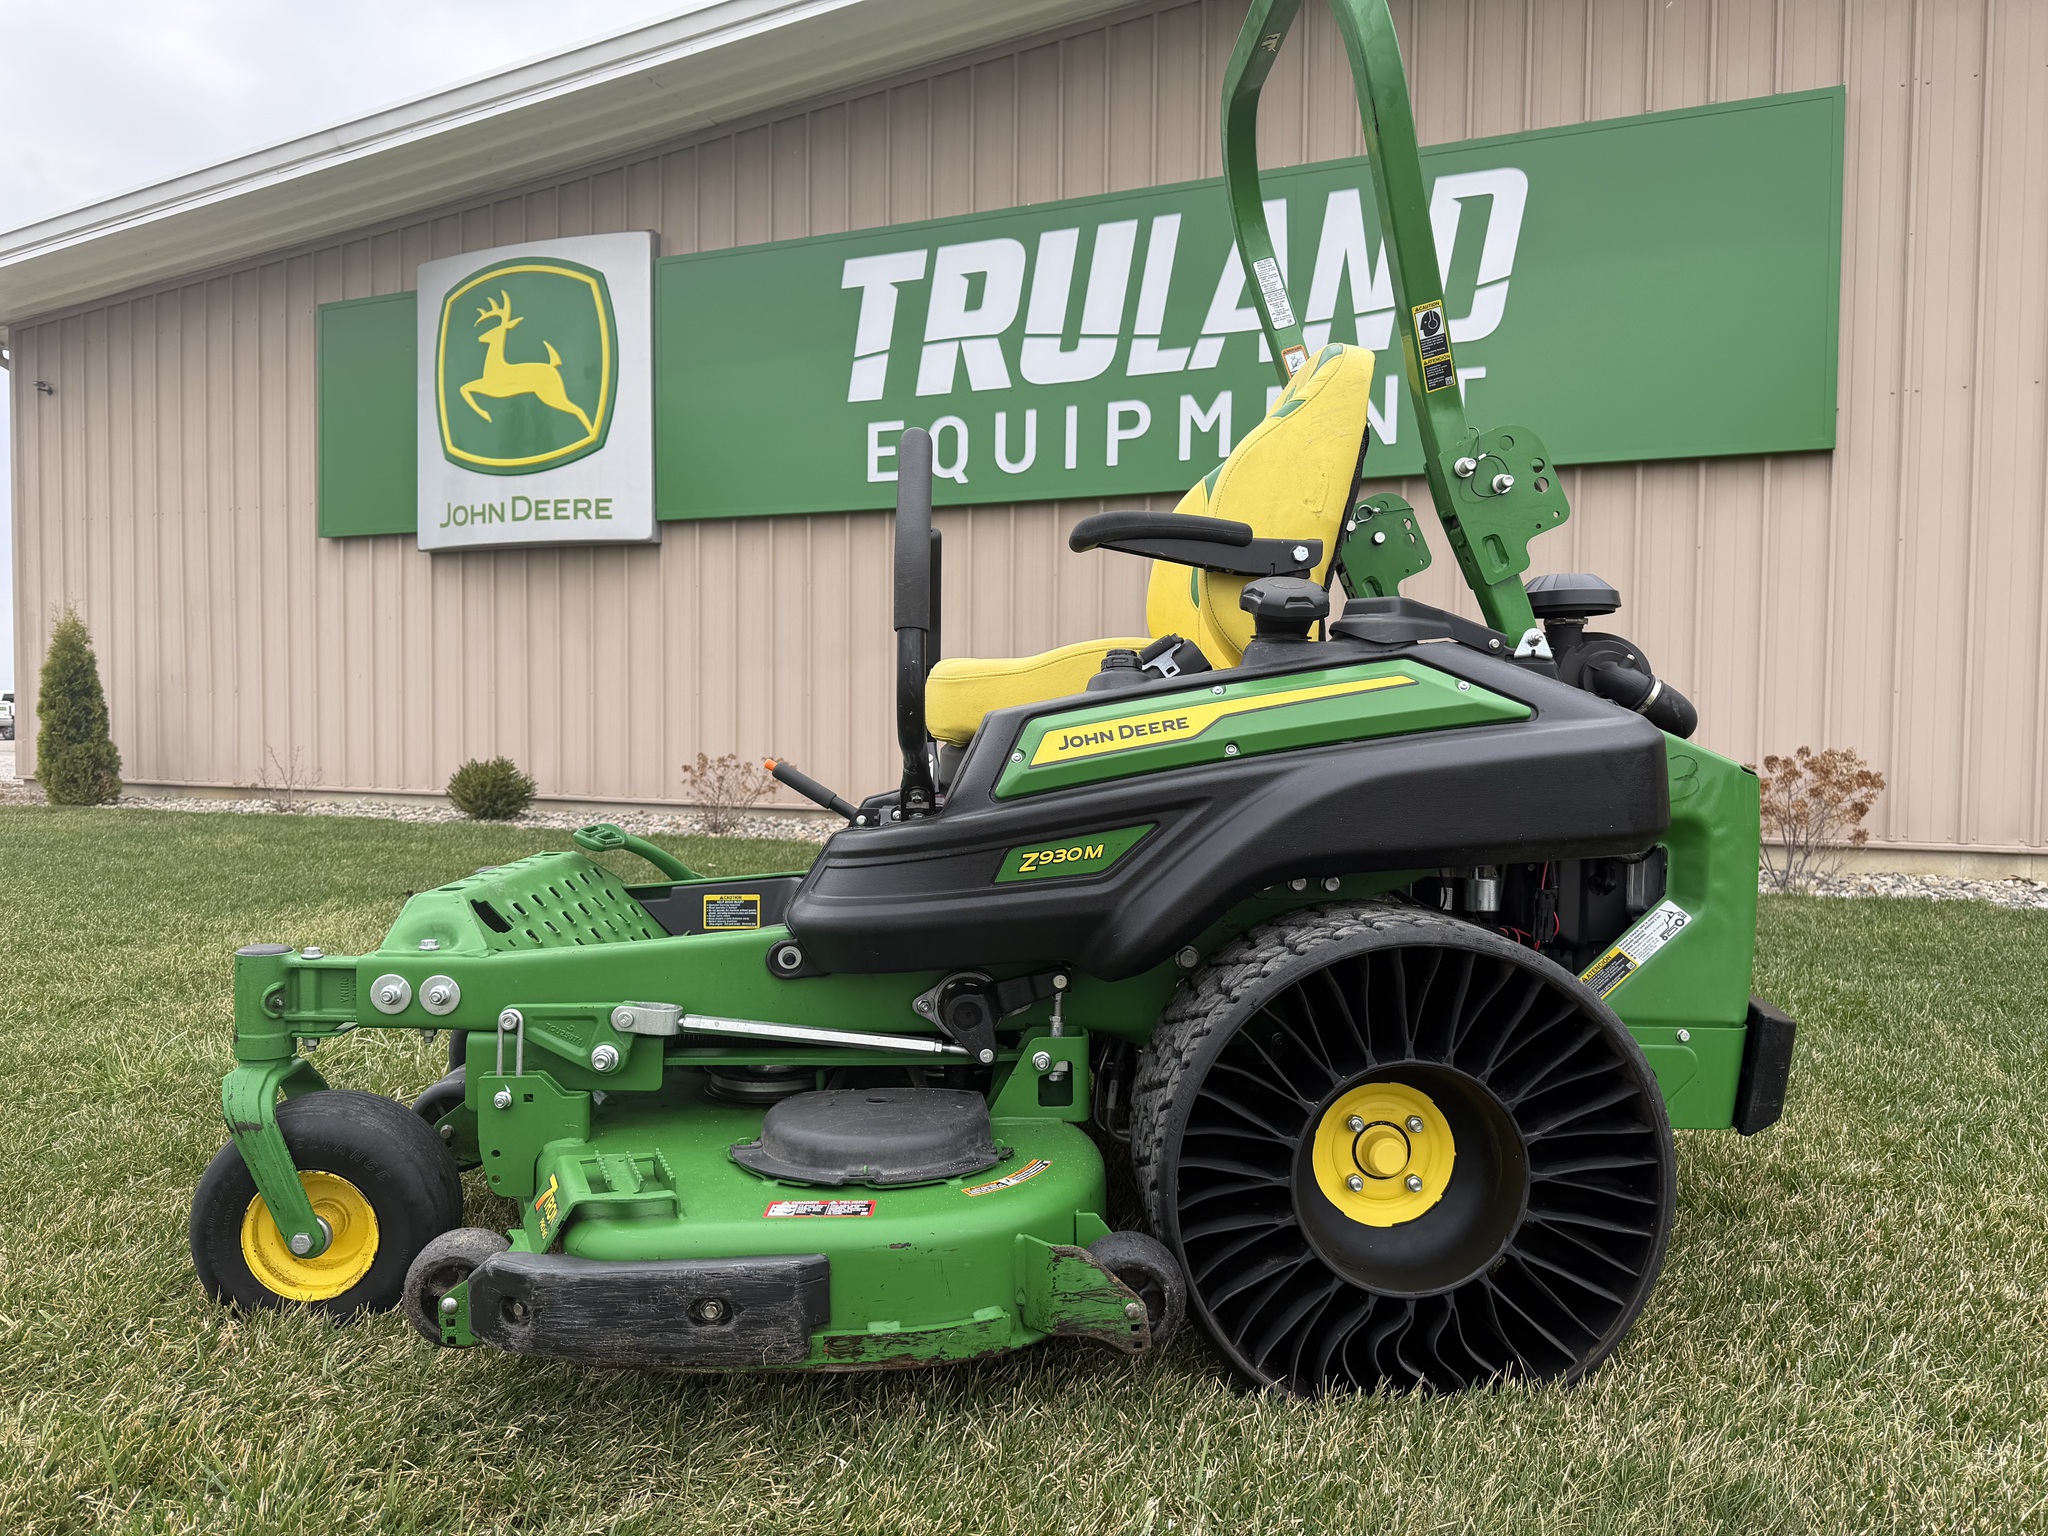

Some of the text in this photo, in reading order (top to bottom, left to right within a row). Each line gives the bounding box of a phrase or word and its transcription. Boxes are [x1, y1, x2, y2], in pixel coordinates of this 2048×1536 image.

[841, 166, 1530, 403] TRULAND
[1418, 302, 1440, 311] CAUTION
[866, 366, 1487, 484] EQUIPMNT
[439, 496, 613, 528] JOHN DEERE
[1058, 717, 1190, 750] JOHN DEERE
[1586, 955, 1612, 979] ATENCIÓN
[286, 1137, 392, 1182] ELIANCE
